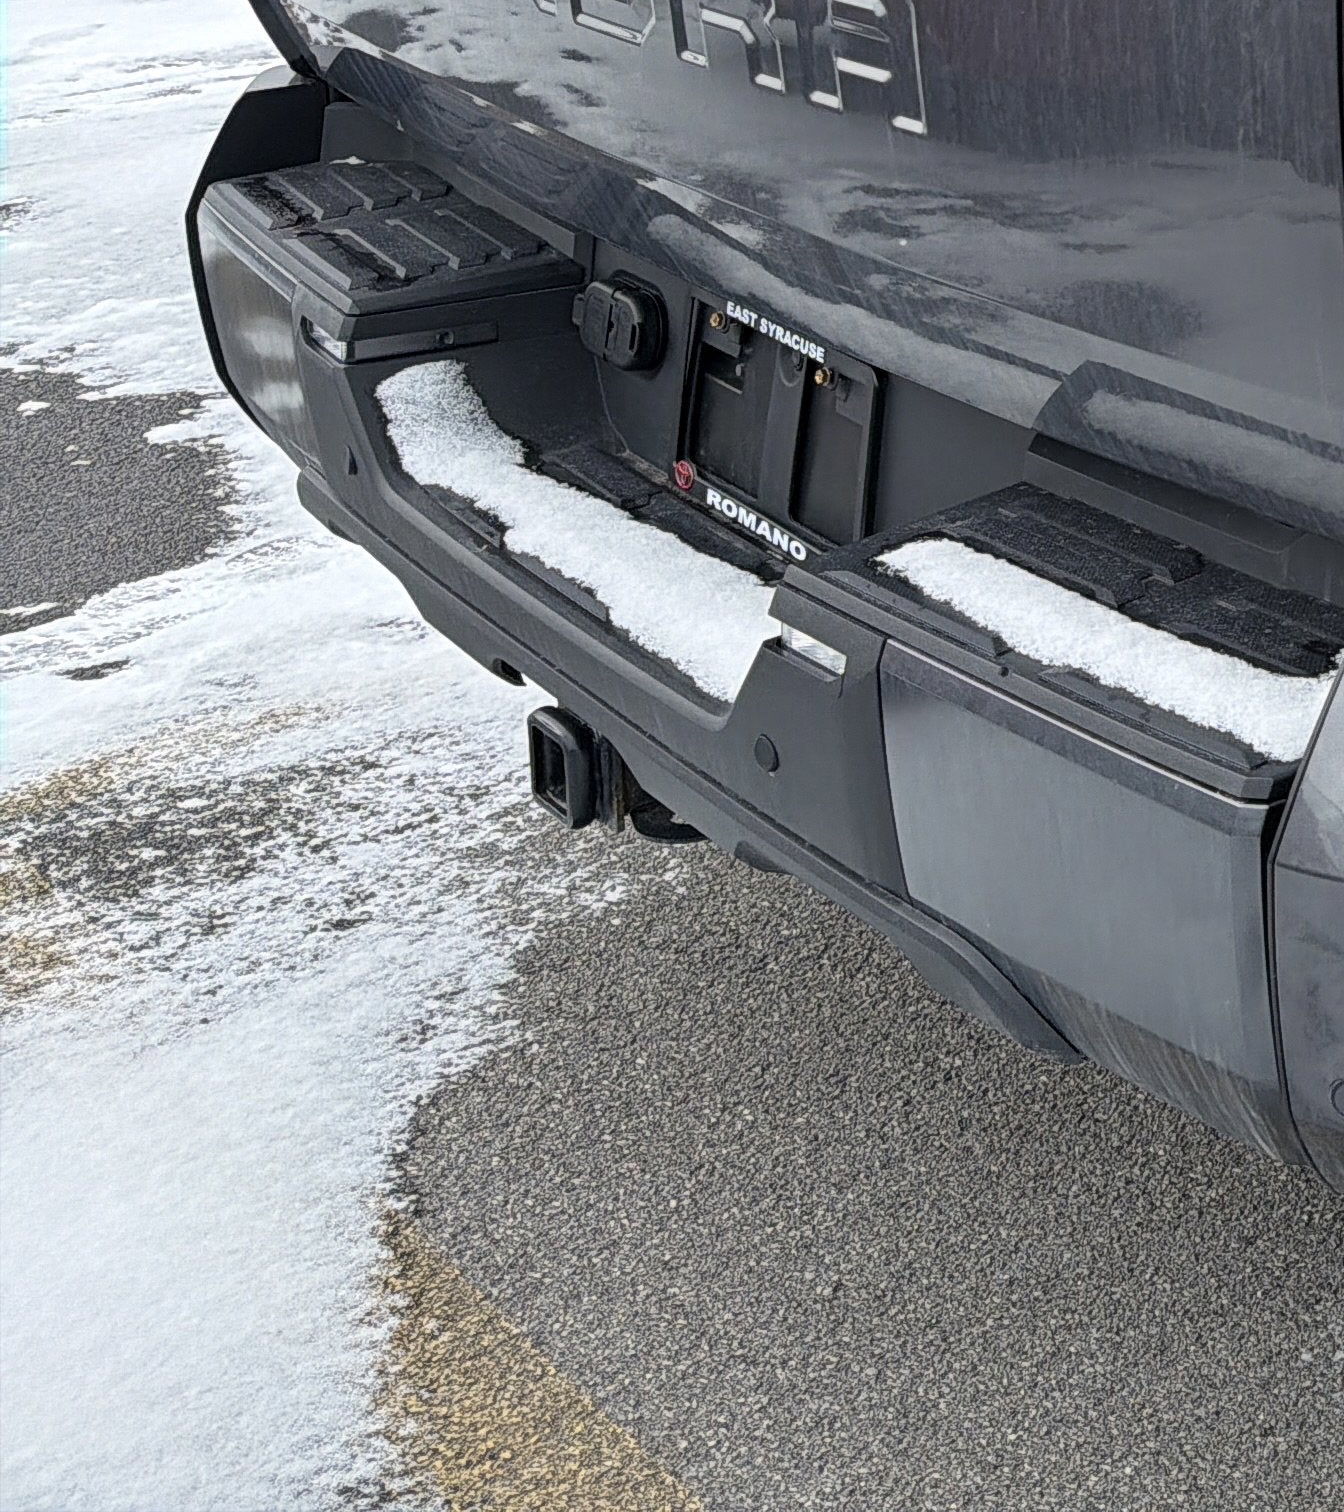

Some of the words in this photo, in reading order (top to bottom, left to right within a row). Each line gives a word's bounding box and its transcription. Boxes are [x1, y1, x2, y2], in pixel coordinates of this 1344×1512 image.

[726, 300, 758, 329] EAST
[759, 317, 826, 364] SYRACUSE
[706, 488, 807, 562] ROMANO
